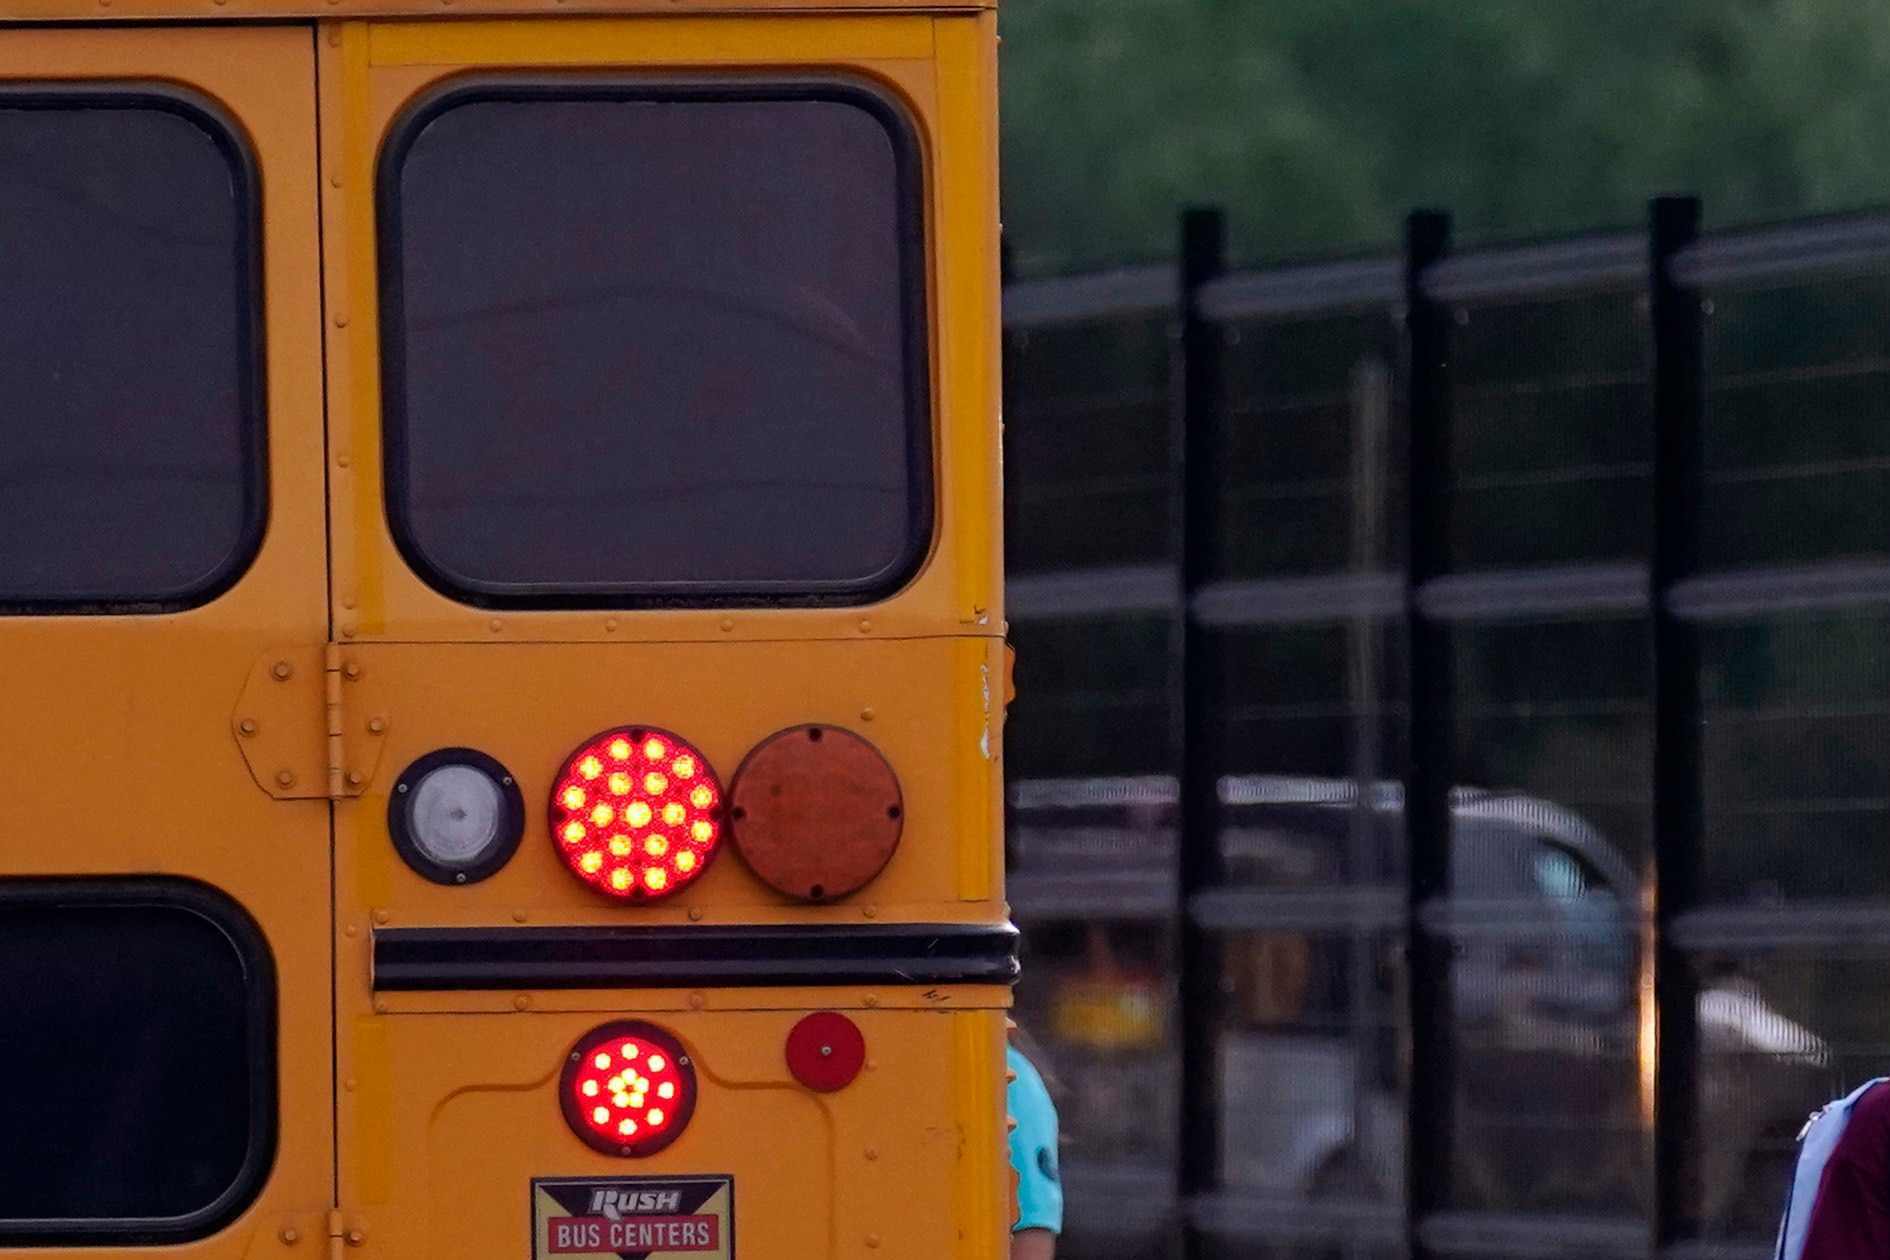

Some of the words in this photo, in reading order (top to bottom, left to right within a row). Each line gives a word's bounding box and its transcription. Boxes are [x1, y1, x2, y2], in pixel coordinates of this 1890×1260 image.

[589, 1189, 680, 1221] RUSH
[557, 1224, 600, 1248] BUS
[610, 1222, 710, 1247] CENTERS
